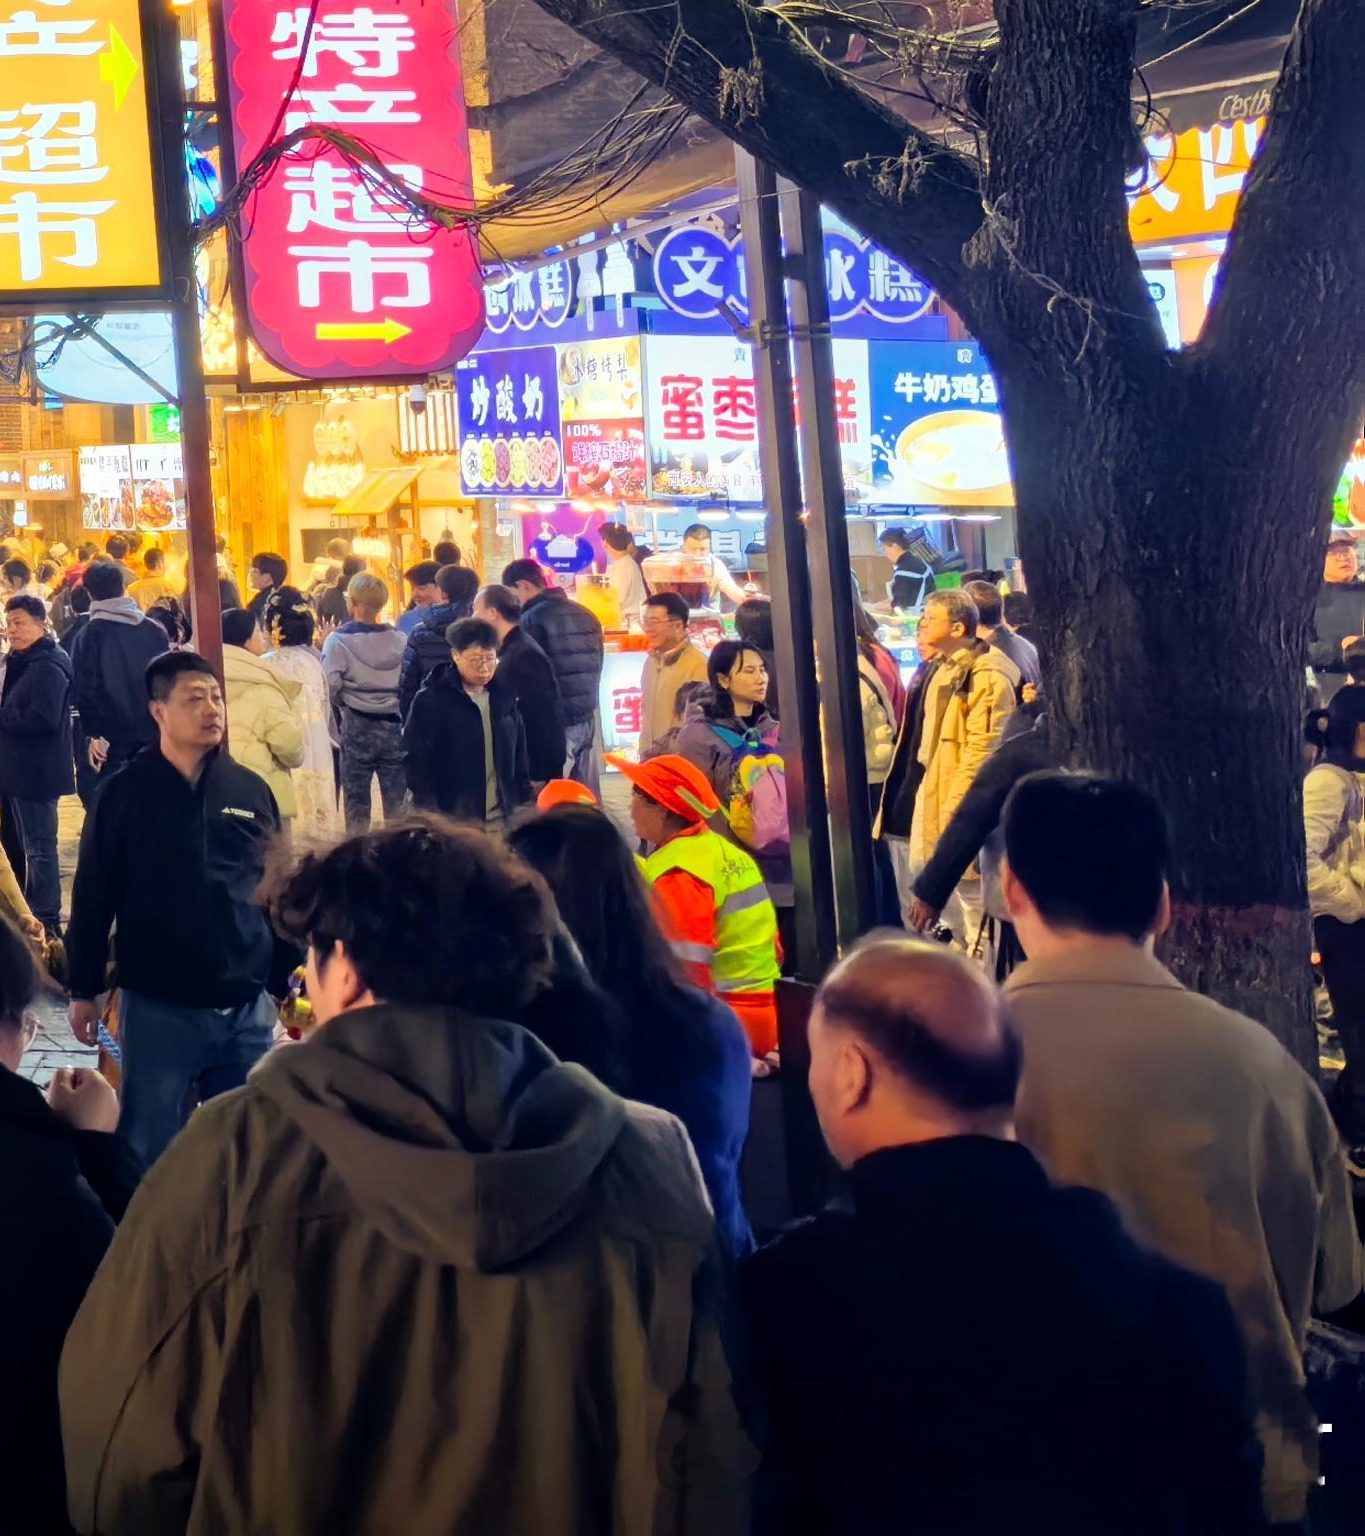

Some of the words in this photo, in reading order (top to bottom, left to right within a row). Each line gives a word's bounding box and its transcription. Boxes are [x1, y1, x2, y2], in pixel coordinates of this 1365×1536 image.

[271, 8, 434, 313] 特产超市
[470, 373, 544, 426] 炒酸奶
[567, 423, 602, 437] 100%
